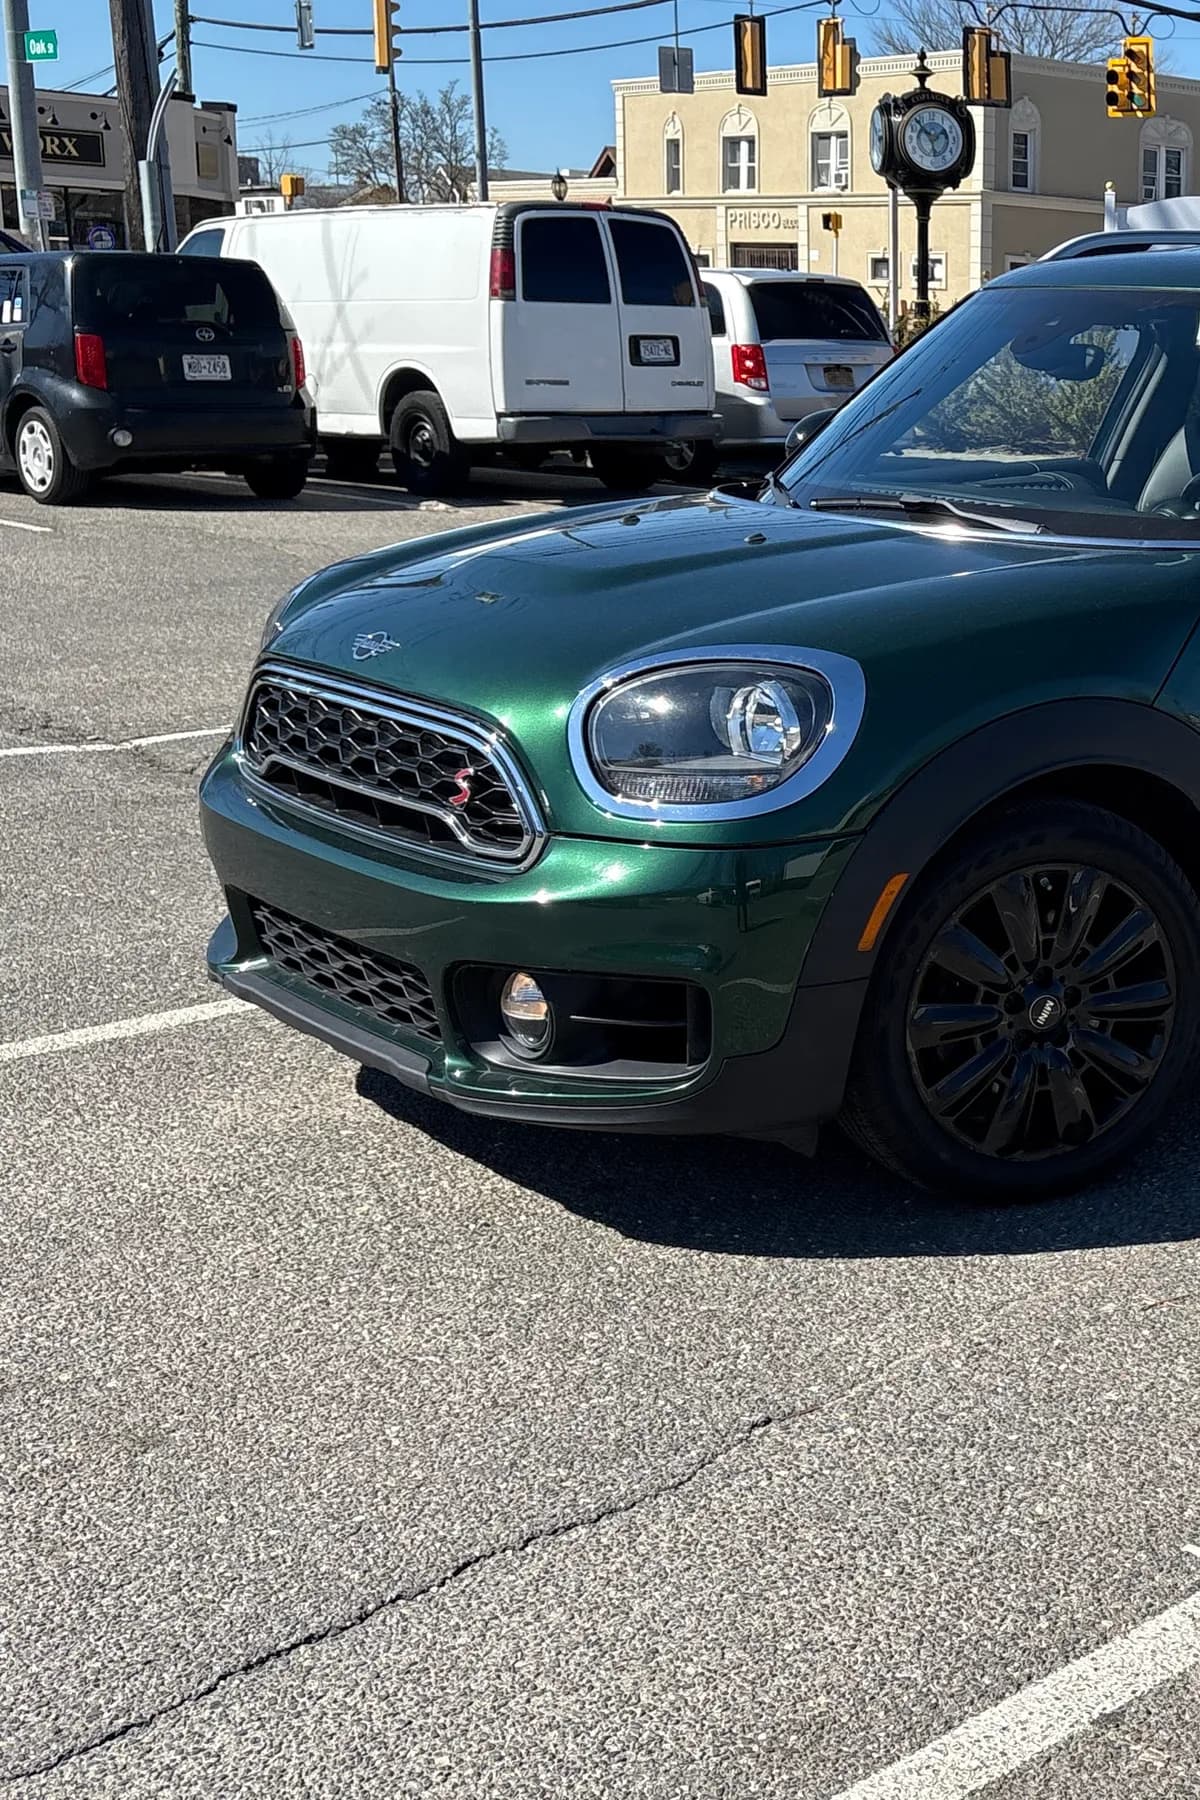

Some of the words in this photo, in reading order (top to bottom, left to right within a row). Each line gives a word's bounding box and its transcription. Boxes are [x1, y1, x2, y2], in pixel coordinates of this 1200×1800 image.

[29, 39, 47, 55] Oak
[729, 210, 782, 230] PRISCO
[448, 767, 474, 806] S
[1036, 999, 1055, 1025] MINI
